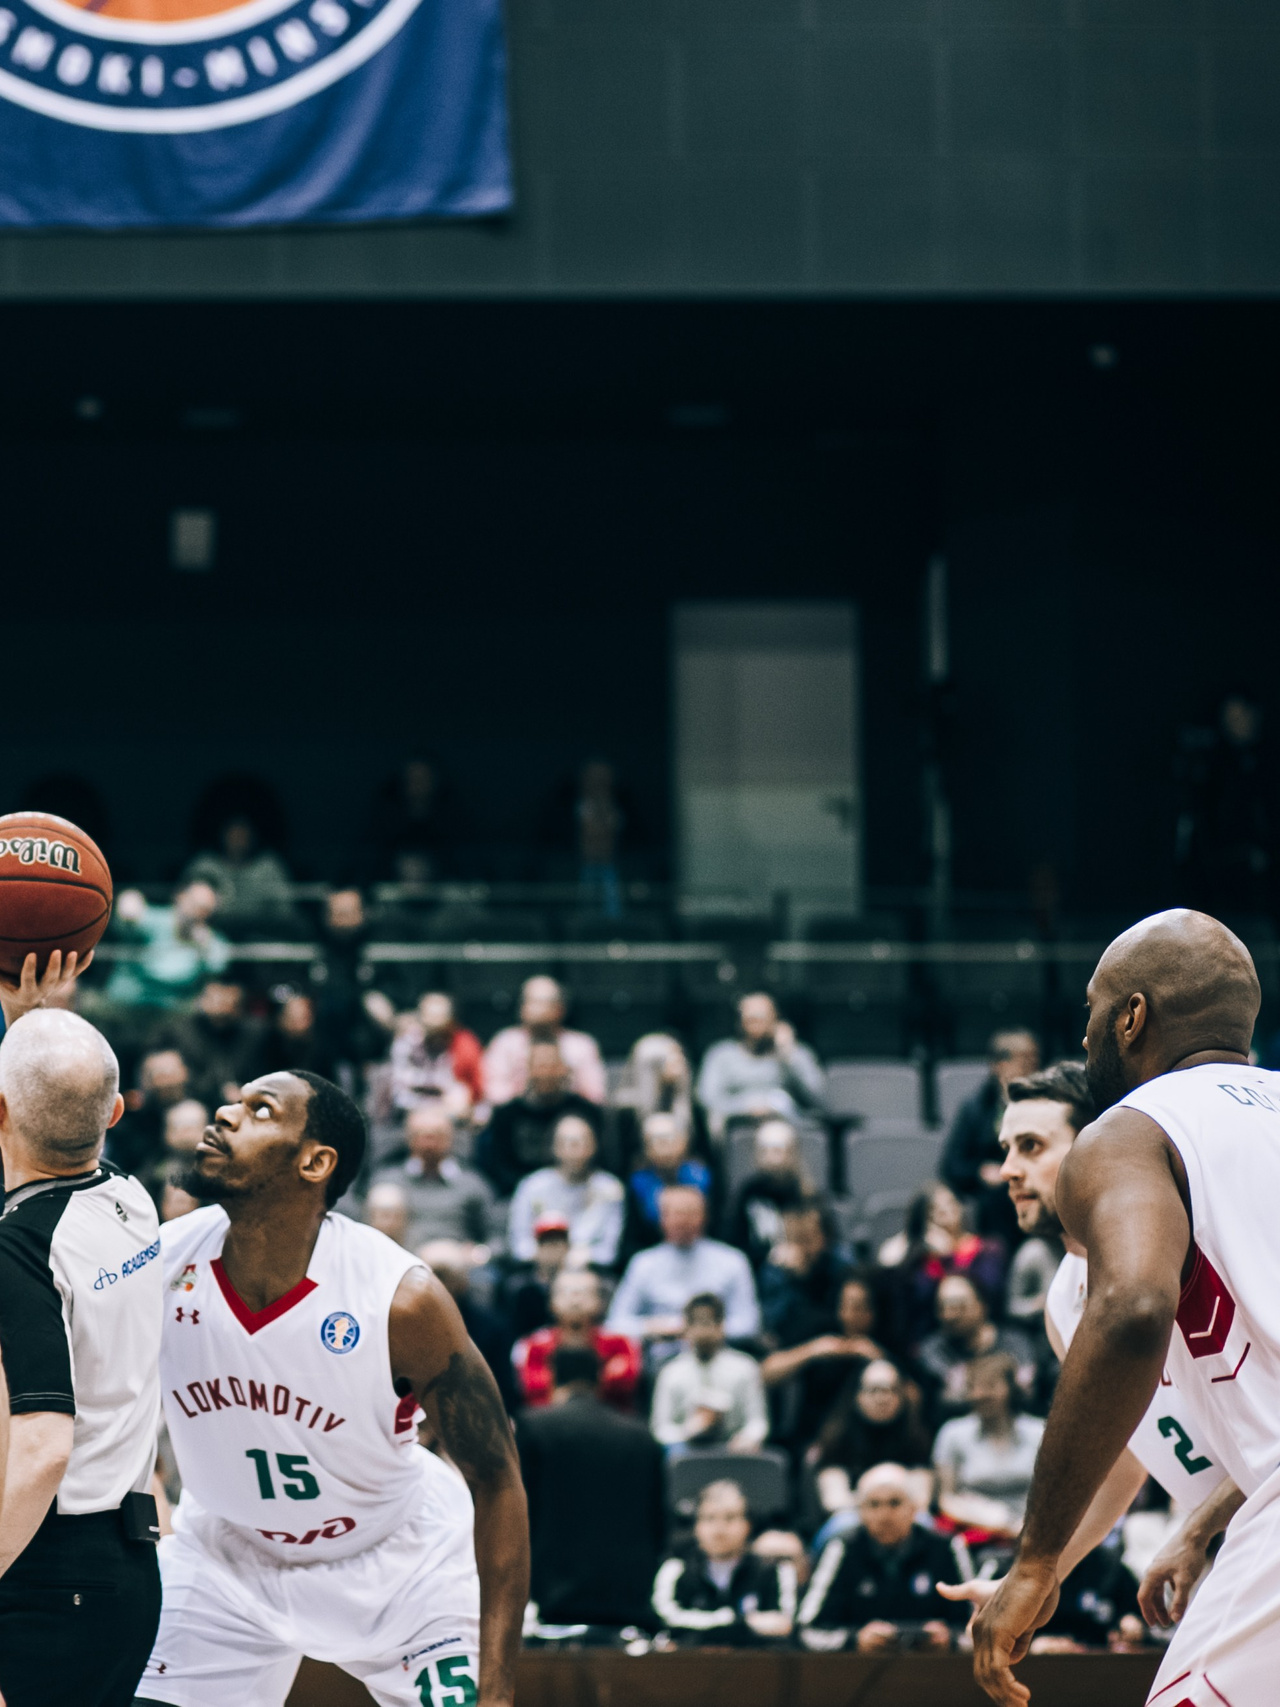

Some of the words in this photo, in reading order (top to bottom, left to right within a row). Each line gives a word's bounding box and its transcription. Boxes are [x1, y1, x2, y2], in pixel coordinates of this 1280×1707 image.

[1217, 1084, 1280, 1113] CO
[172, 1376, 346, 1432] LOKOMOTIV
[245, 1448, 321, 1501] 15
[414, 1655, 478, 1707] 15
